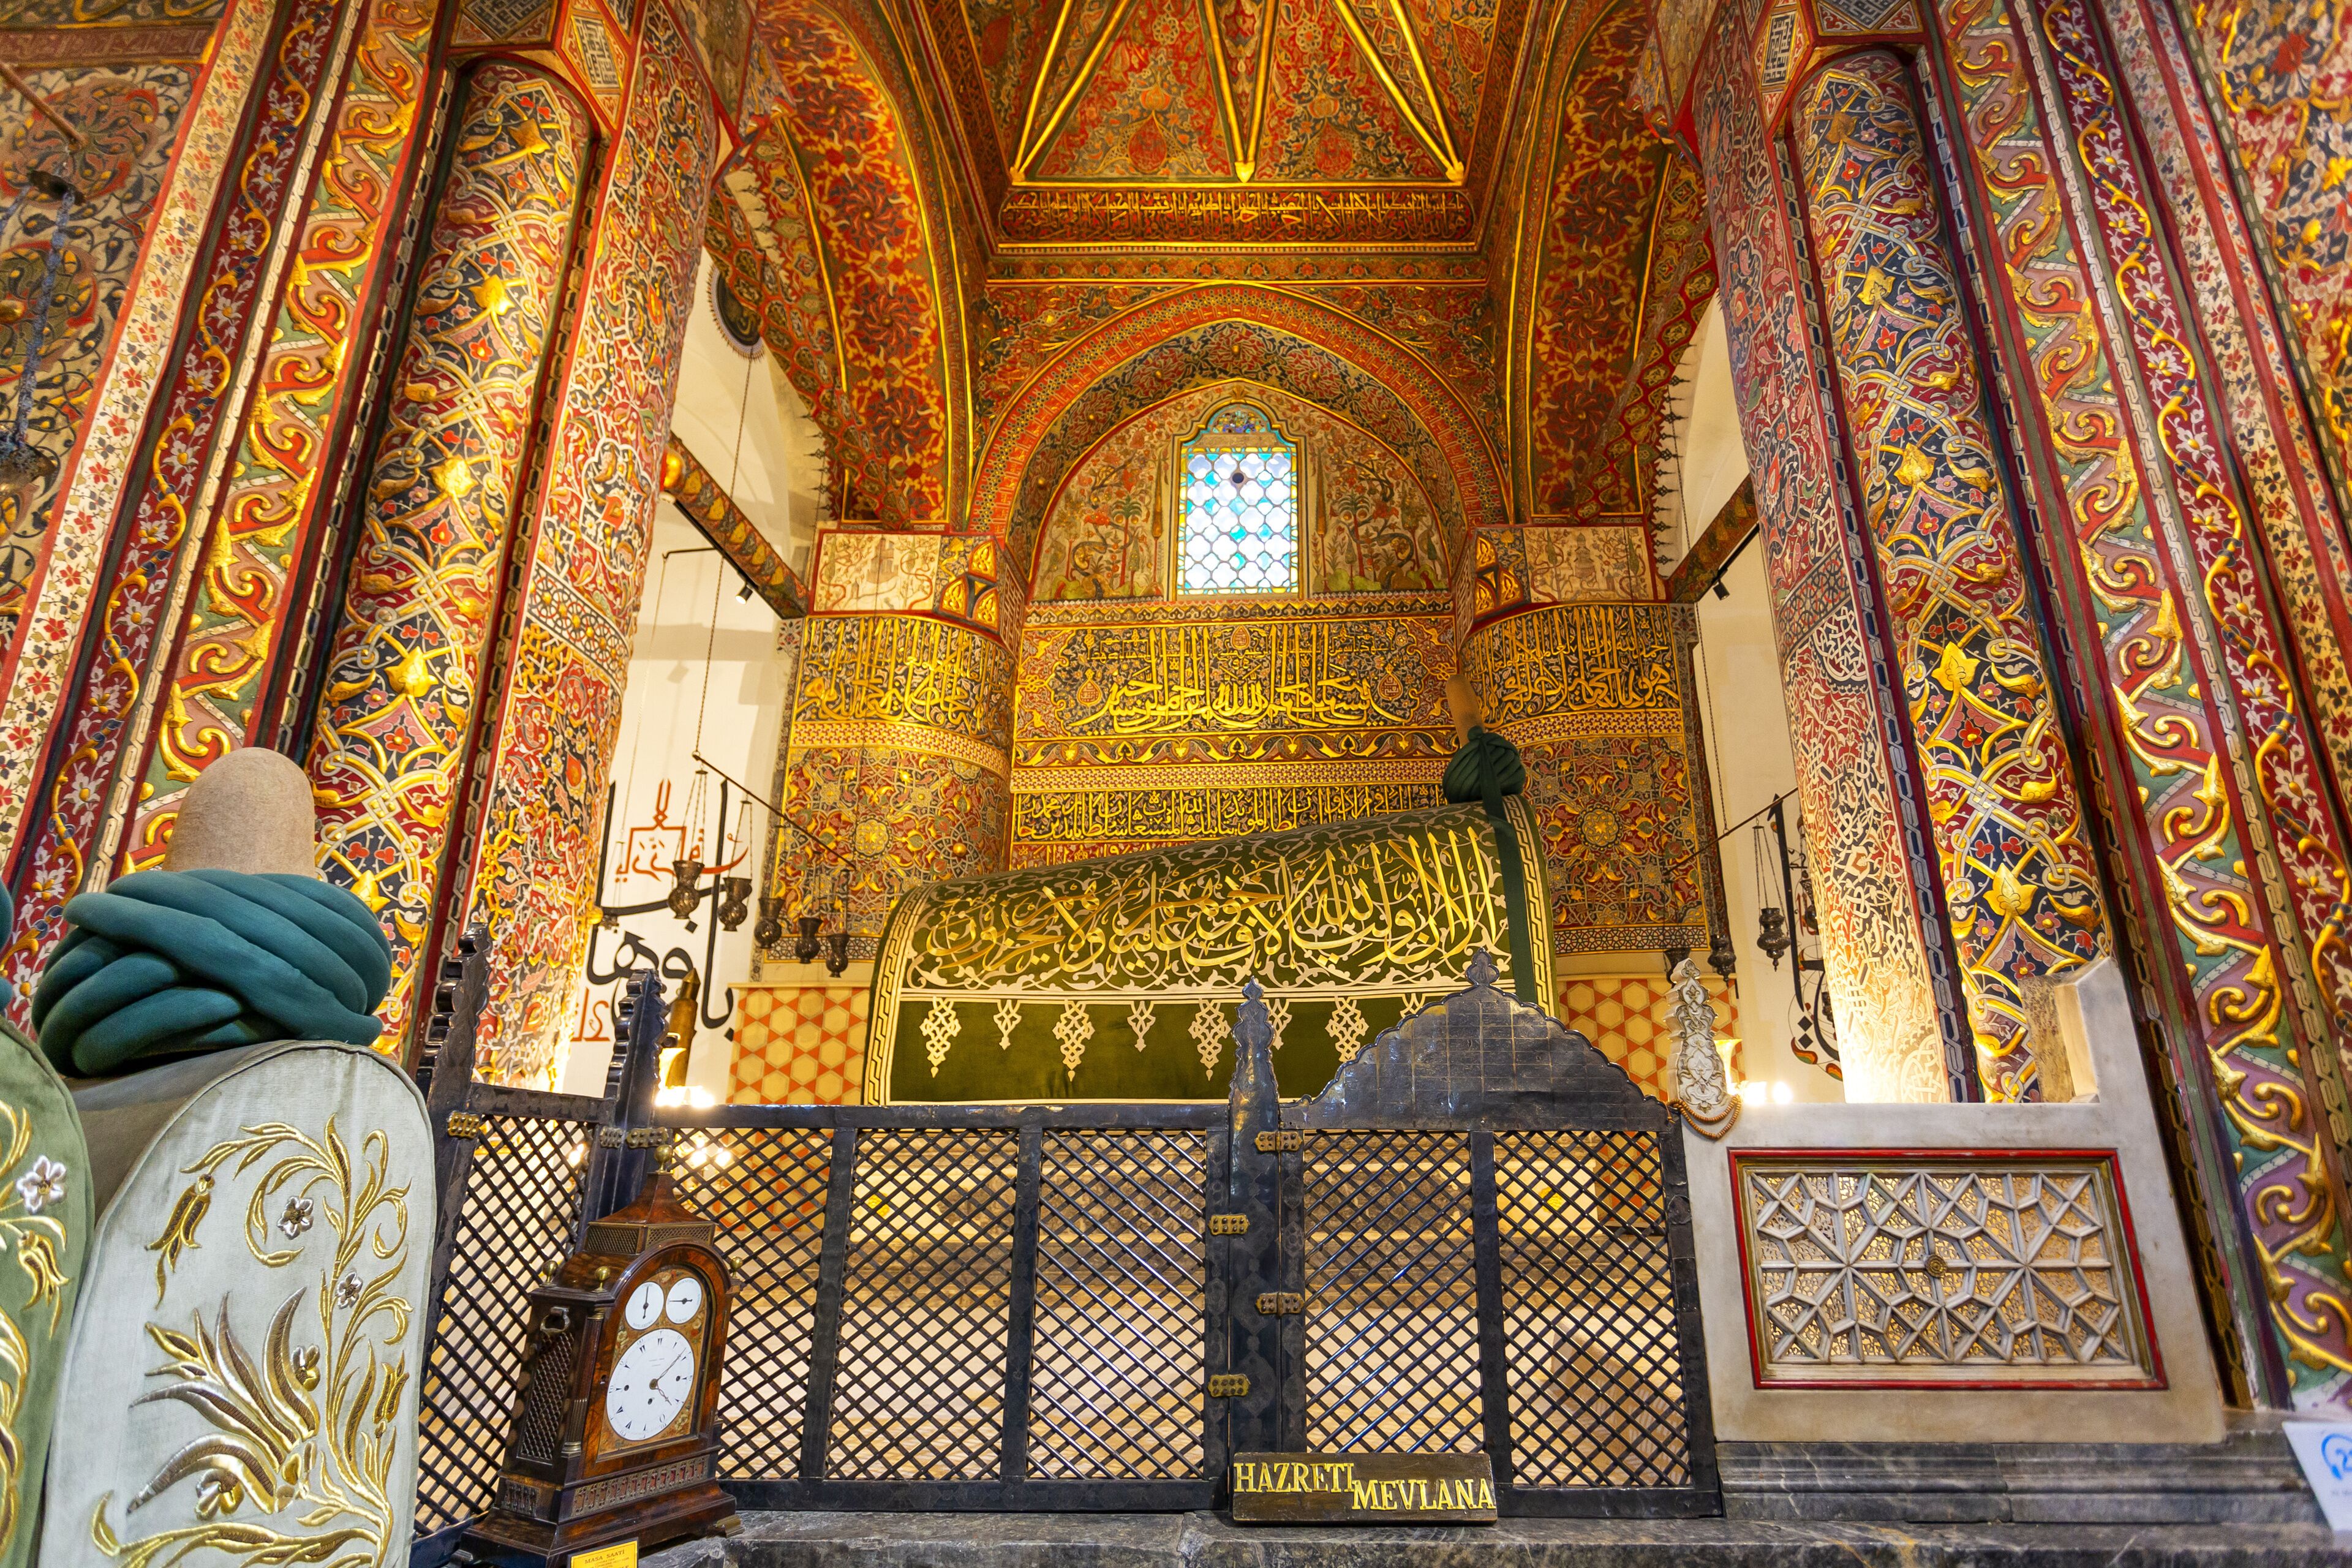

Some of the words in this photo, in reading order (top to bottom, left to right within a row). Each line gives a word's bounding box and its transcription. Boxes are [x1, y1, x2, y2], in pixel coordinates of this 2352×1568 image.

[1234, 1462, 1354, 1493] HAZRETI
[1351, 1479, 1496, 1510] MEVLANA
[584, 1555, 603, 1564] MASA
